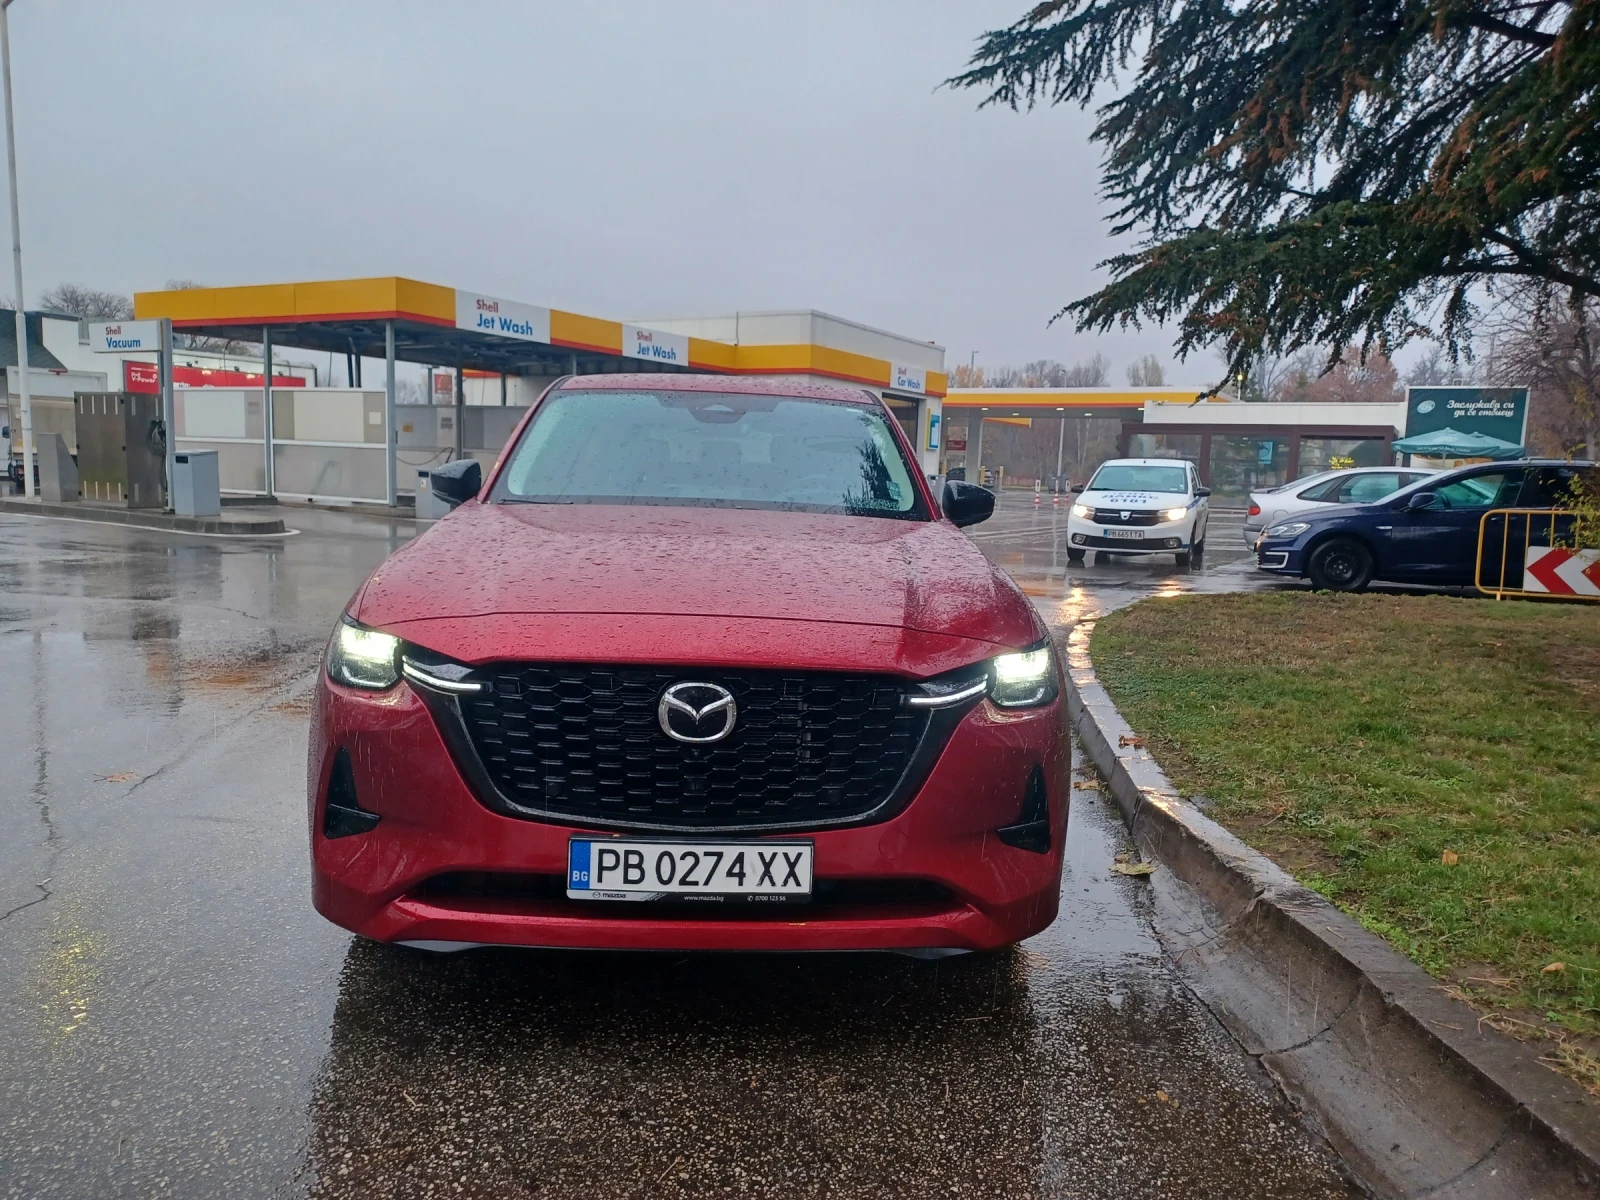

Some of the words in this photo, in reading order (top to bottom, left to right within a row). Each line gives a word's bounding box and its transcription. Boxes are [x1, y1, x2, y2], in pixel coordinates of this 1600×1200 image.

[476, 299, 499, 313] Shell
[105, 326, 121, 335] Shell
[477, 313, 495, 329] Jet
[499, 317, 533, 336] Wash
[106, 337, 141, 348] Vacuum
[636, 331, 653, 342] Shell
[637, 342, 650, 356] Jet
[652, 345, 676, 361] Wash
[897, 376, 906, 387] Car
[907, 379, 920, 389] Wash
[1446, 399, 1501, 411] Заслужава
[1453, 409, 1466, 418] да
[597, 848, 646, 885] PB
[655, 850, 746, 887] 0274
[756, 851, 804, 887] XX
[572, 870, 589, 882] BG
